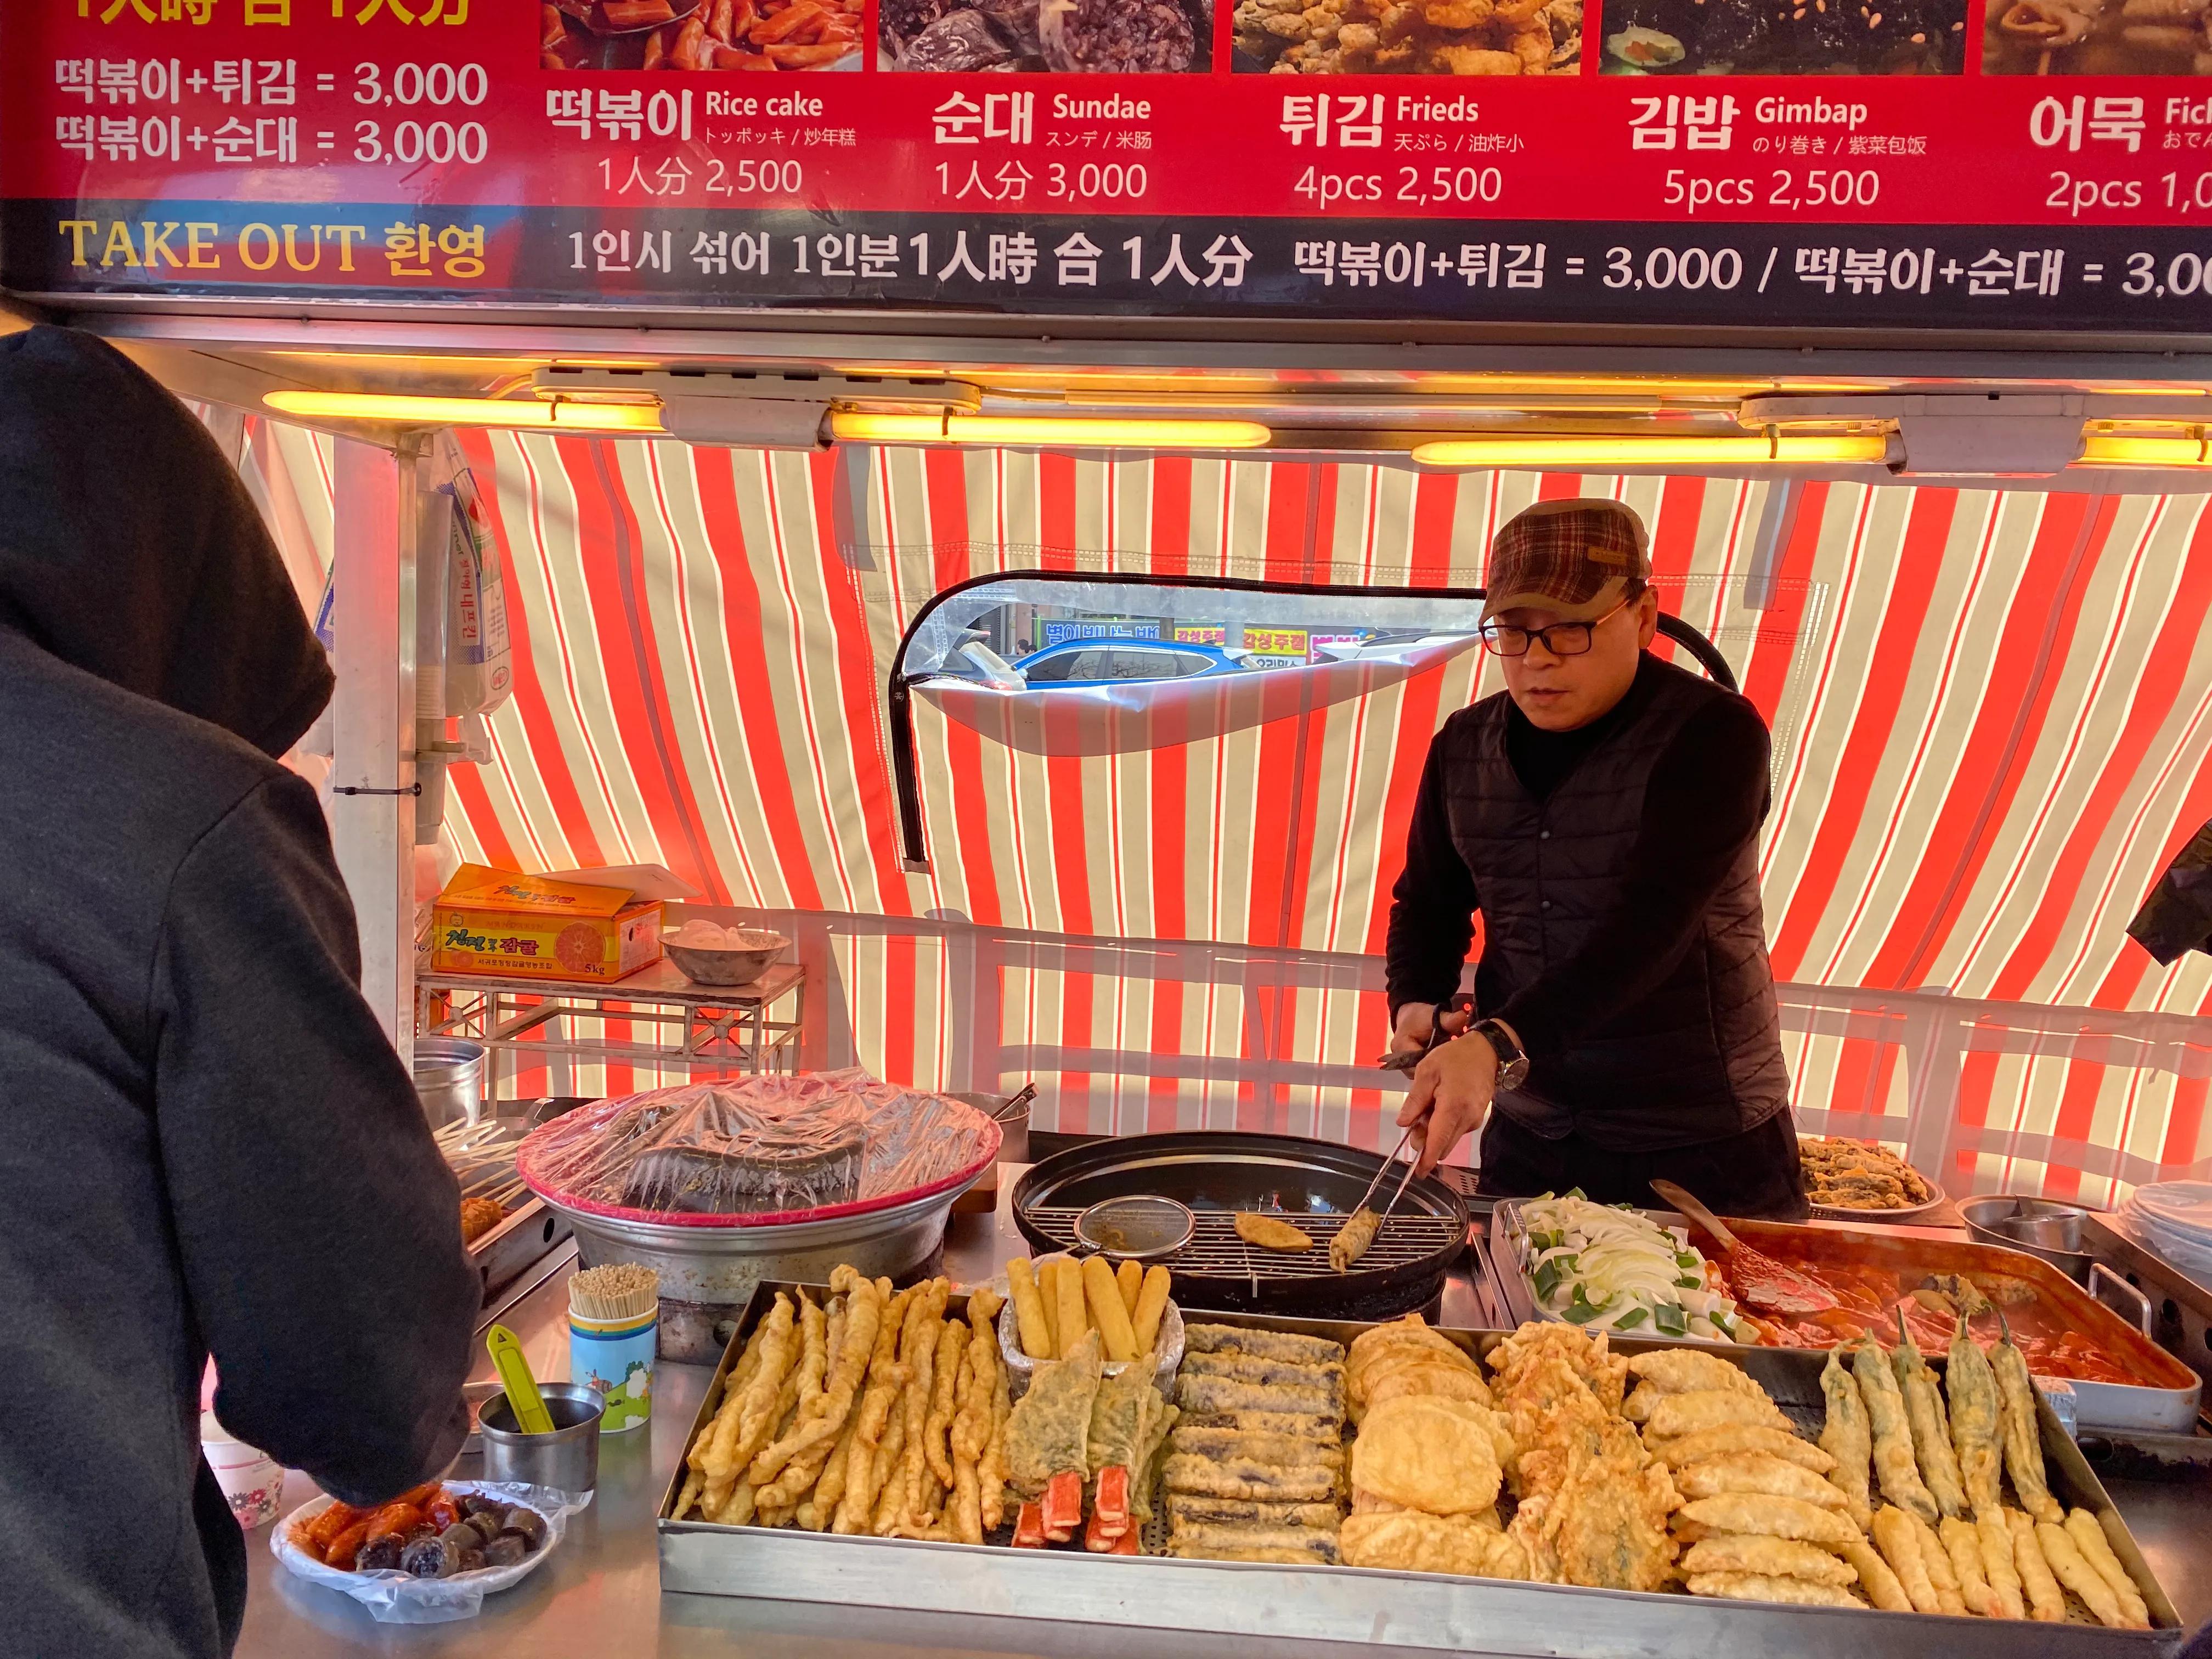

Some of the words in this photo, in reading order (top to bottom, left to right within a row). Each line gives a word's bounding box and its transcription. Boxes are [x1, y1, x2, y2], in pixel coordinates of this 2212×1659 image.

[56, 58, 297, 104] 떡볶이+튀김
[317, 73, 334, 91] =
[354, 63, 488, 108] 3,000
[706, 91, 757, 116] Rice
[765, 91, 823, 116] cake
[546, 88, 692, 140] 떡볶이
[932, 91, 1035, 144] 순대
[1053, 93, 1151, 119] Sundae
[1279, 93, 1385, 147] 튀김
[1397, 95, 1479, 122] Frieds
[1628, 94, 1740, 150] 김밥
[1756, 97, 1867, 131] Gimbap
[2030, 95, 2146, 152] 어묵
[56, 115, 297, 162] 떡볶이+순대
[317, 131, 334, 149] =
[354, 121, 488, 165] 3,000
[706, 127, 786, 144] トッポッキ
[804, 127, 856, 146] 炒年糕
[1046, 131, 1097, 147] スンデ
[1394, 133, 1448, 151] 天ぷら
[1469, 133, 1524, 153] 油炸小
[1753, 136, 1827, 154] のり巻き
[1848, 136, 1927, 155] 紫菜包饭
[599, 156, 692, 195] 1人分
[706, 159, 802, 196] 2,500
[935, 160, 1033, 201] 1人分
[1047, 163, 1147, 202] 3,000
[1294, 166, 1383, 210] 4pcs
[1396, 167, 1502, 206] 2,500
[1664, 170, 1754, 214] 5pcs
[1769, 170, 1879, 210] 2,500
[2046, 171, 2142, 217] 2pcs
[59, 220, 220, 269] TAKE
[238, 223, 365, 272] OUT
[384, 222, 485, 278] 환영
[569, 229, 672, 273] 1인시
[690, 230, 770, 274] 섞어
[1053, 232, 1103, 286] 合
[1123, 233, 1254, 287] 1人分
[1294, 240, 1546, 289] 떡볶이+튀김
[1566, 257, 1584, 275] =
[1602, 247, 1742, 291] 3,000
[1758, 247, 1778, 293] /
[1795, 247, 2064, 296] 떡볶이+순대
[2084, 263, 2103, 281] =
[460, 594, 476, 638] 내프킨
